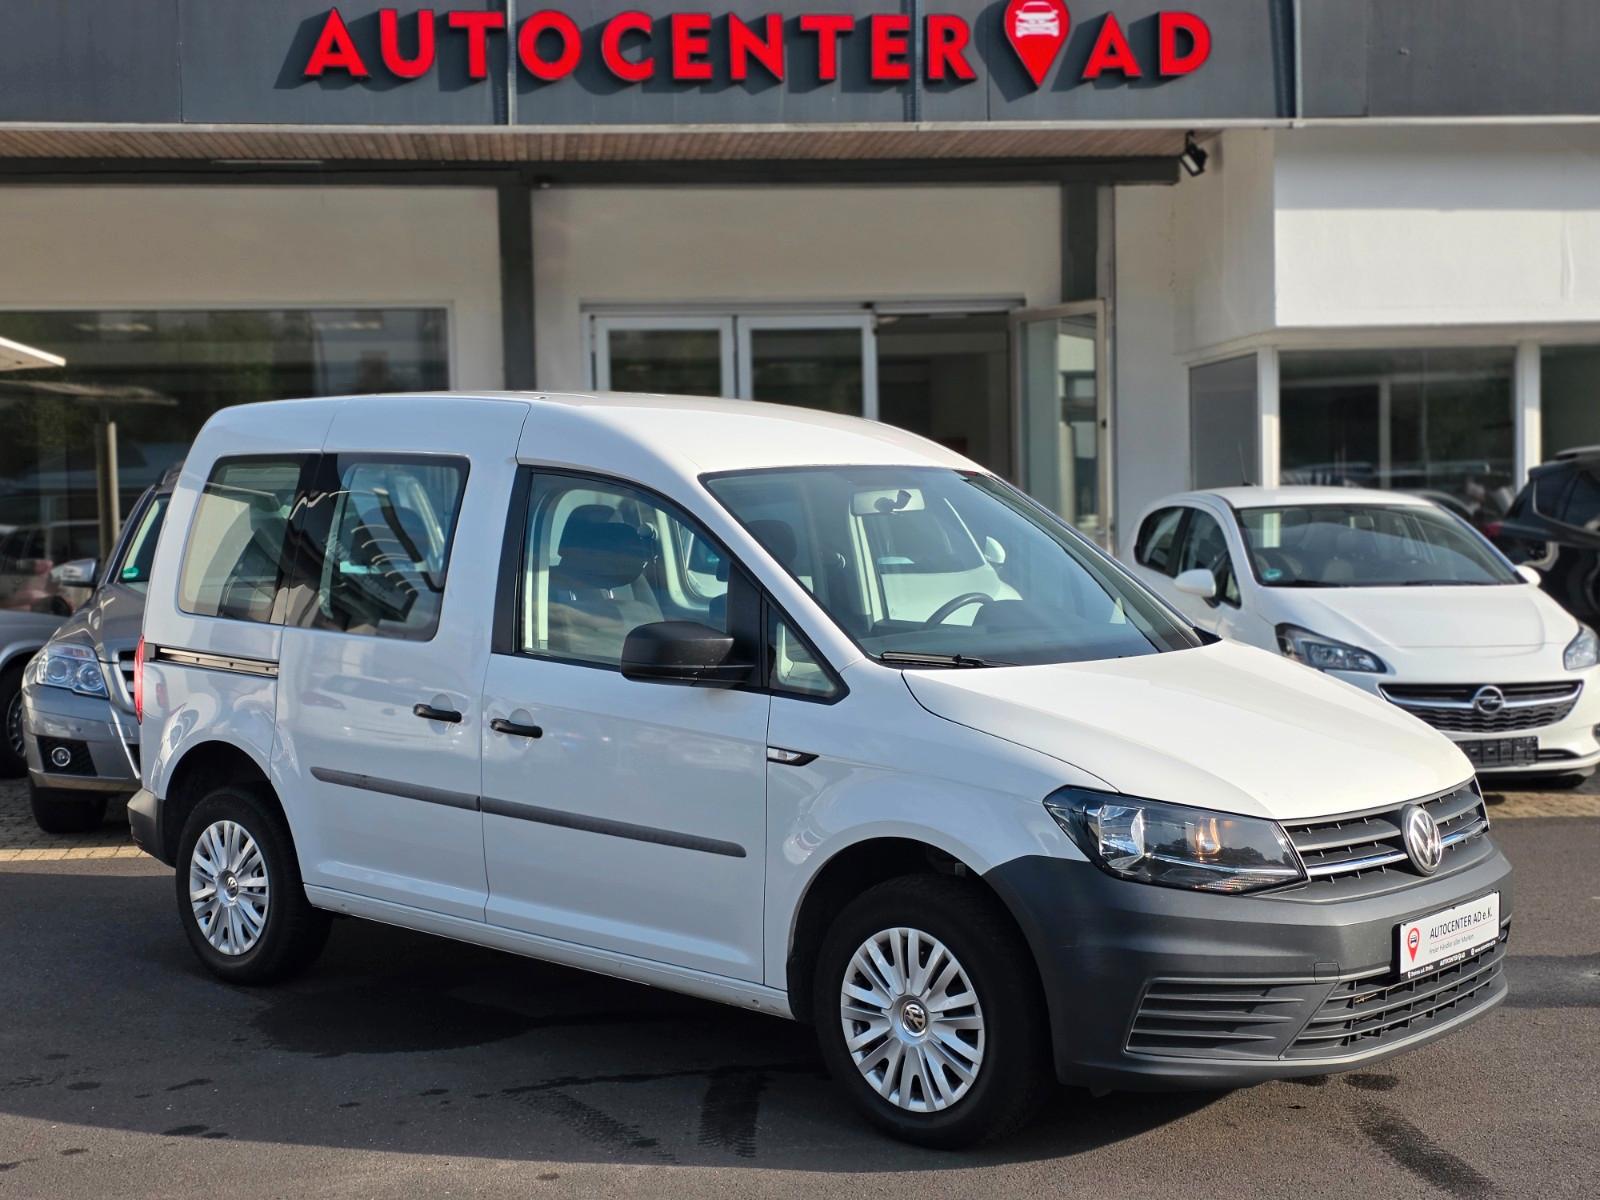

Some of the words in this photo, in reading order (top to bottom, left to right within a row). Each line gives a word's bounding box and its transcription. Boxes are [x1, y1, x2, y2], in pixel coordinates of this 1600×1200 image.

[304, 8, 977, 81] AUTOCENTER
[1082, 10, 1212, 79] AD
[1429, 914, 1472, 939] AUTOCENTER
[1473, 911, 1482, 923] AD
